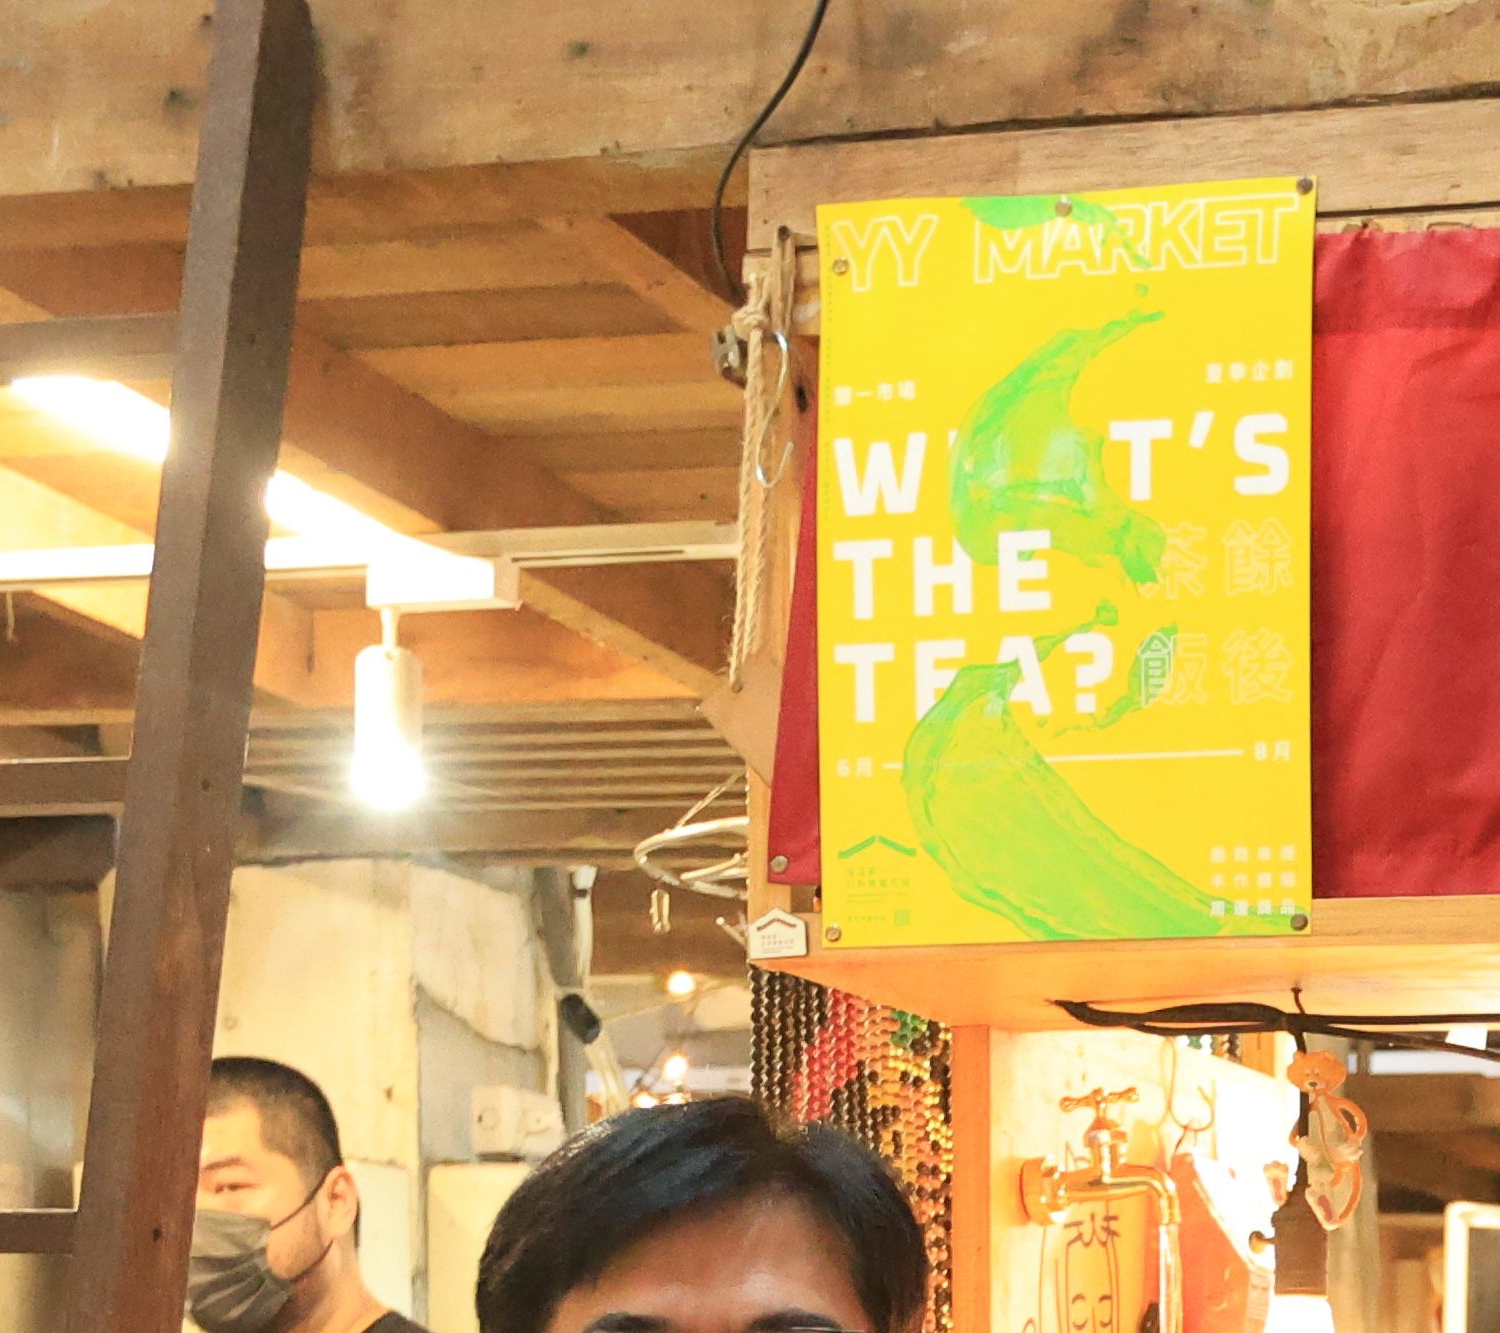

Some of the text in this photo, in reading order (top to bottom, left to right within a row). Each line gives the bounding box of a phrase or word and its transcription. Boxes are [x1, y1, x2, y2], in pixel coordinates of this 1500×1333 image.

[834, 194, 1300, 292] YY MARKET
[834, 412, 1290, 517] WT'S
[834, 529, 1053, 621] THE
[834, 631, 1114, 724] TEA?
[1136, 628, 1295, 710] 飯後
